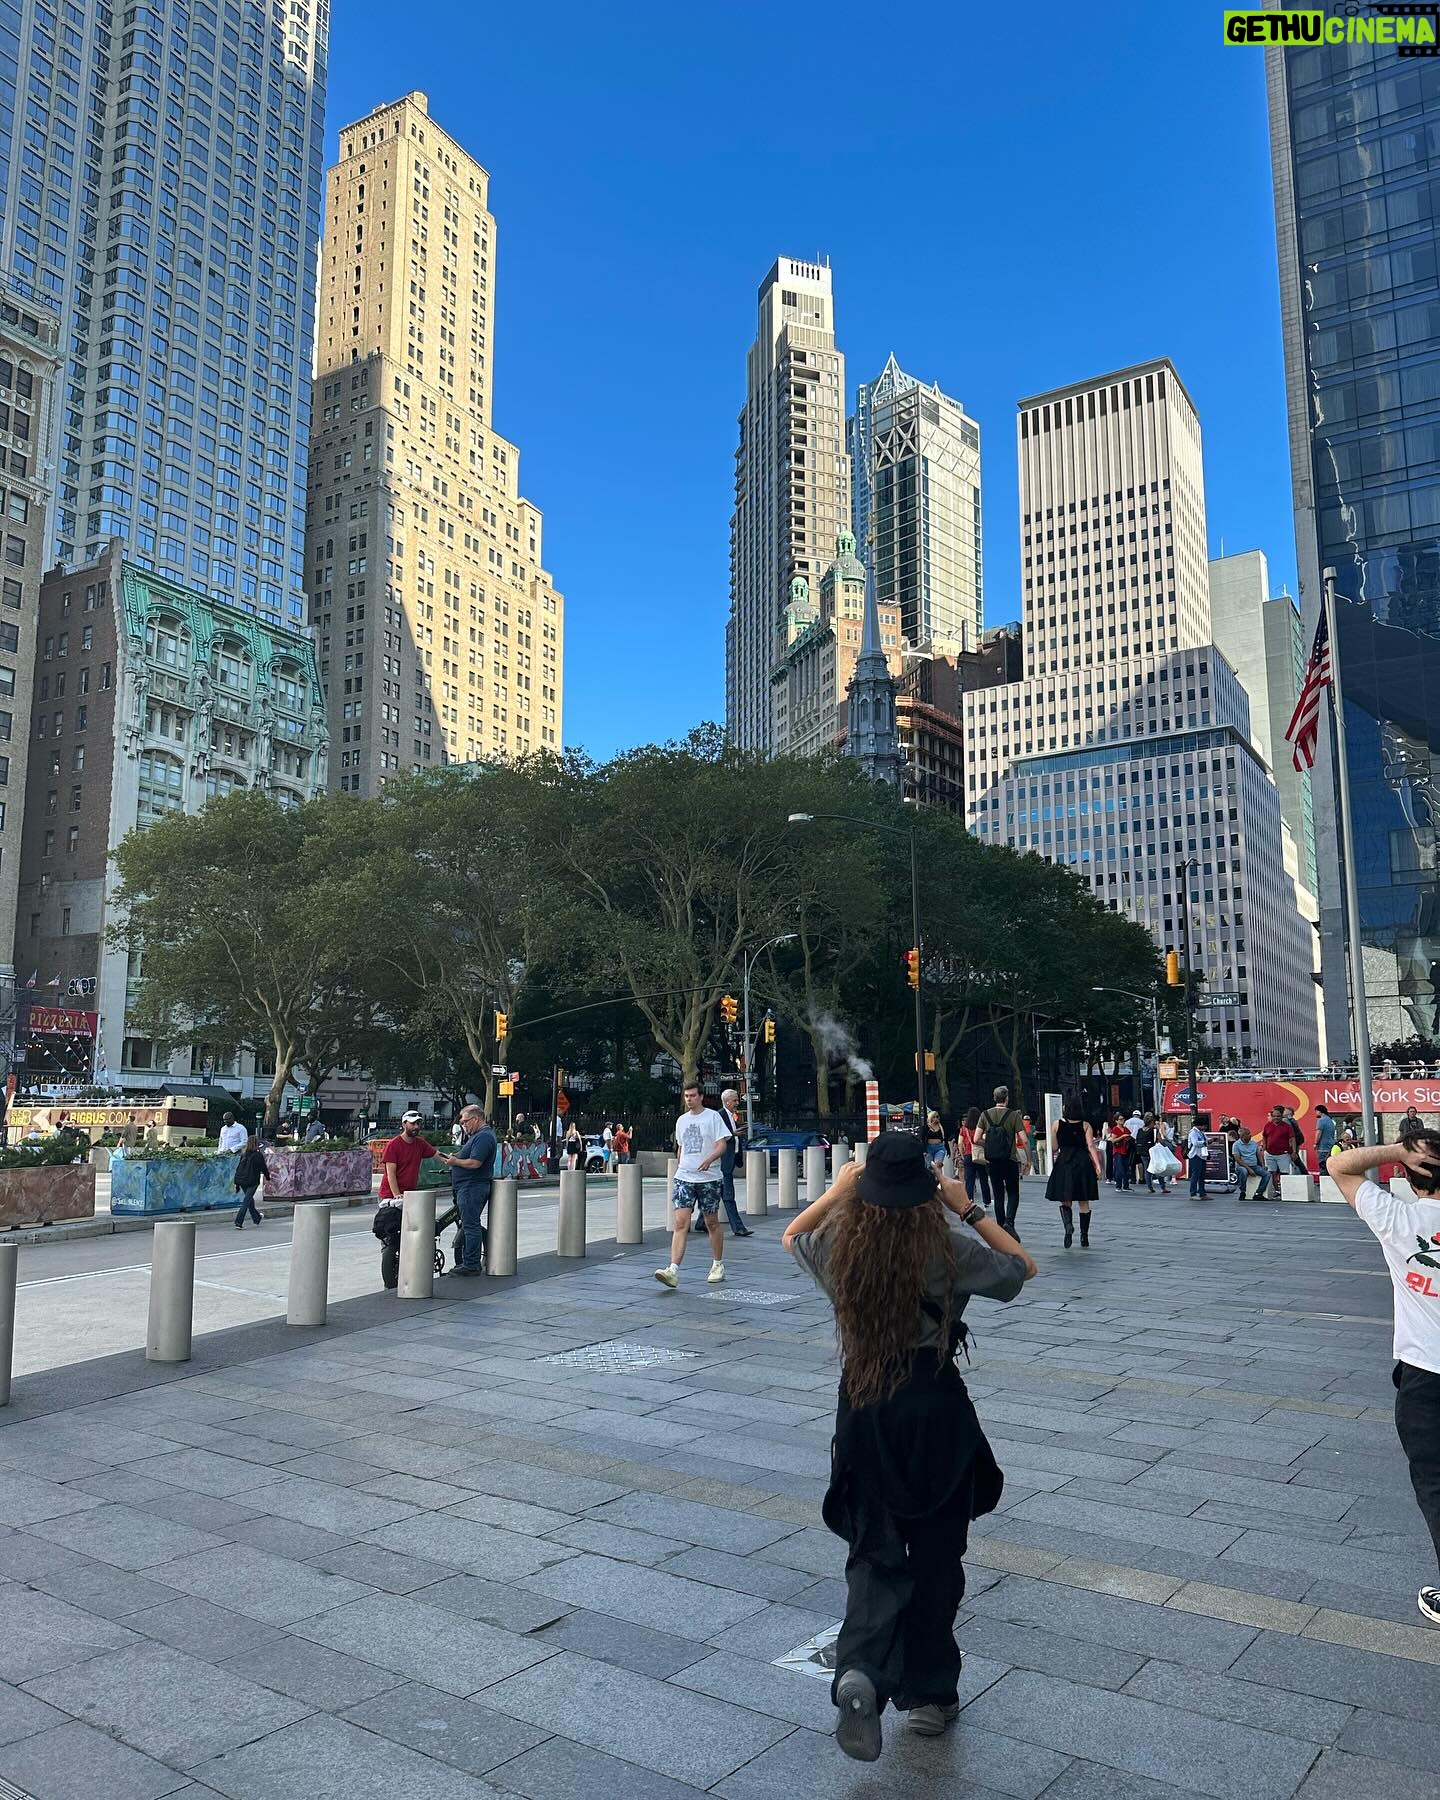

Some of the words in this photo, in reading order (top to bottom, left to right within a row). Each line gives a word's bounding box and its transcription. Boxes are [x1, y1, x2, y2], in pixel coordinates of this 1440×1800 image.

[1212, 997, 1233, 1006] Church
[29, 1011, 87, 1030] PIZZERIA
[1324, 1088, 1362, 1104] New
[1371, 1087, 1410, 1103] York
[69, 1111, 132, 1124] BIGBUS.COM
